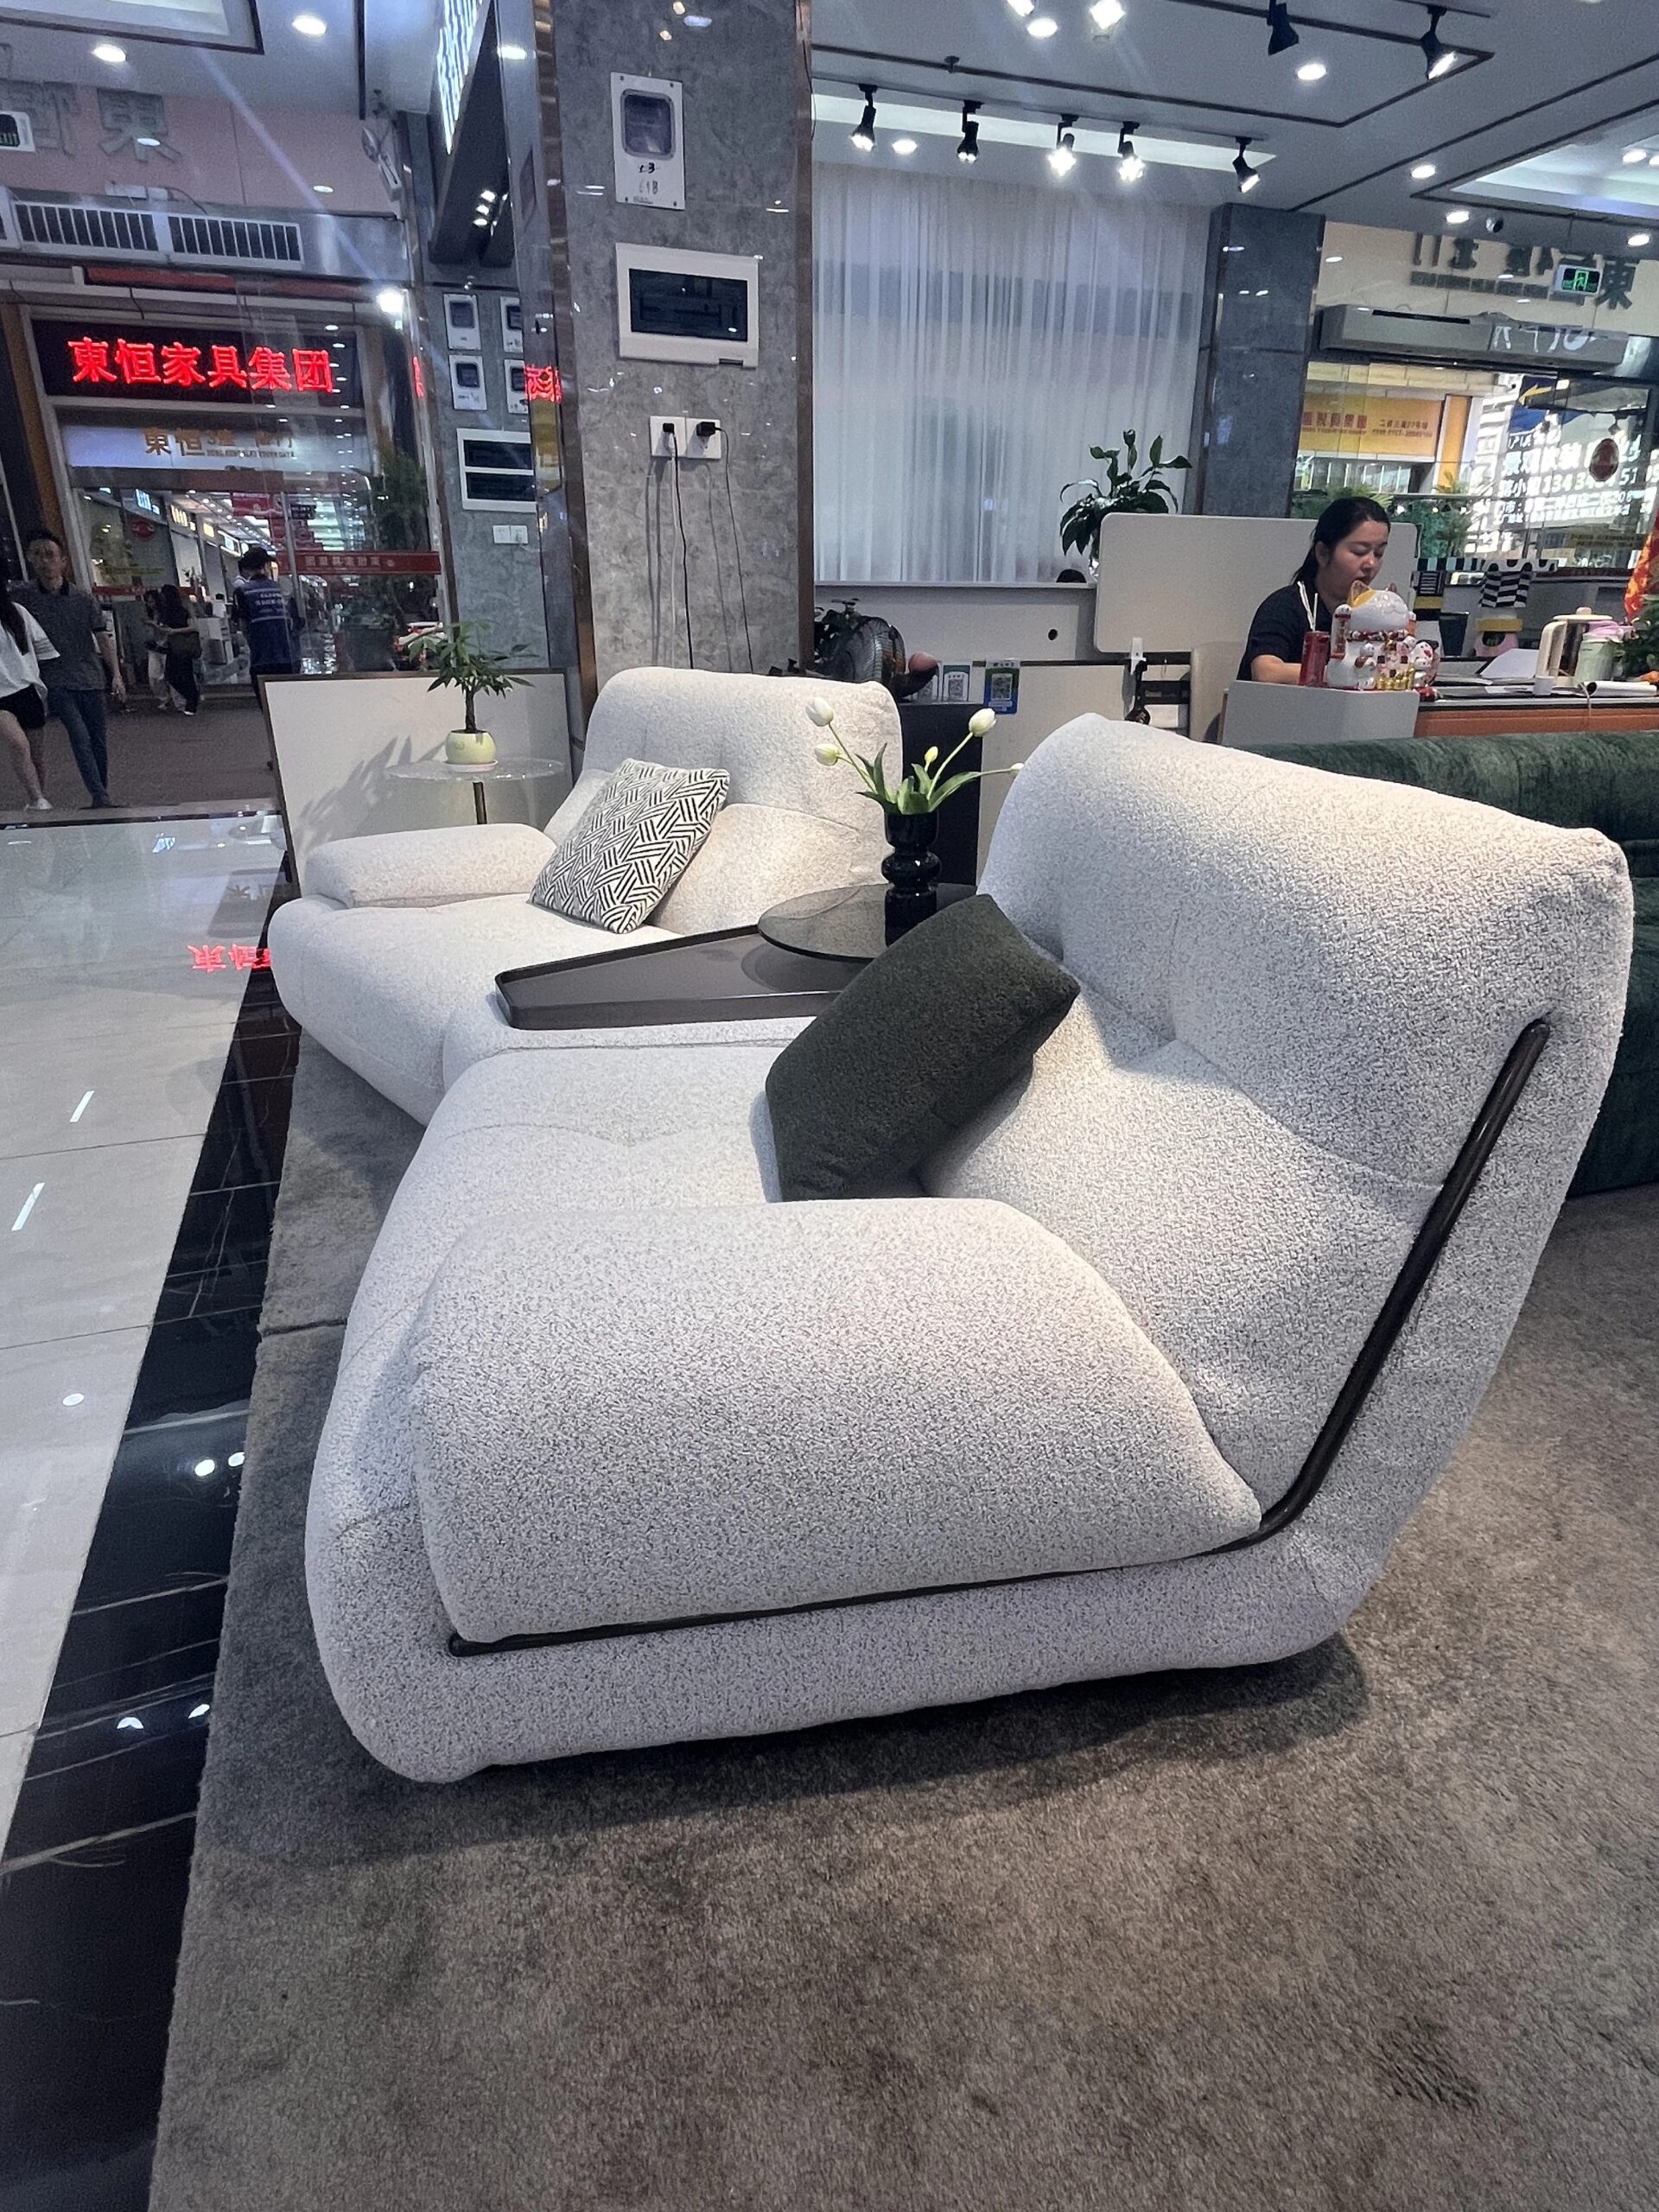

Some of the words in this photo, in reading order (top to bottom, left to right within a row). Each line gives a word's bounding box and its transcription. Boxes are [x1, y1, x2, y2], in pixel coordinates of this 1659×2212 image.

[67, 336, 334, 393] 東恒家具集团
